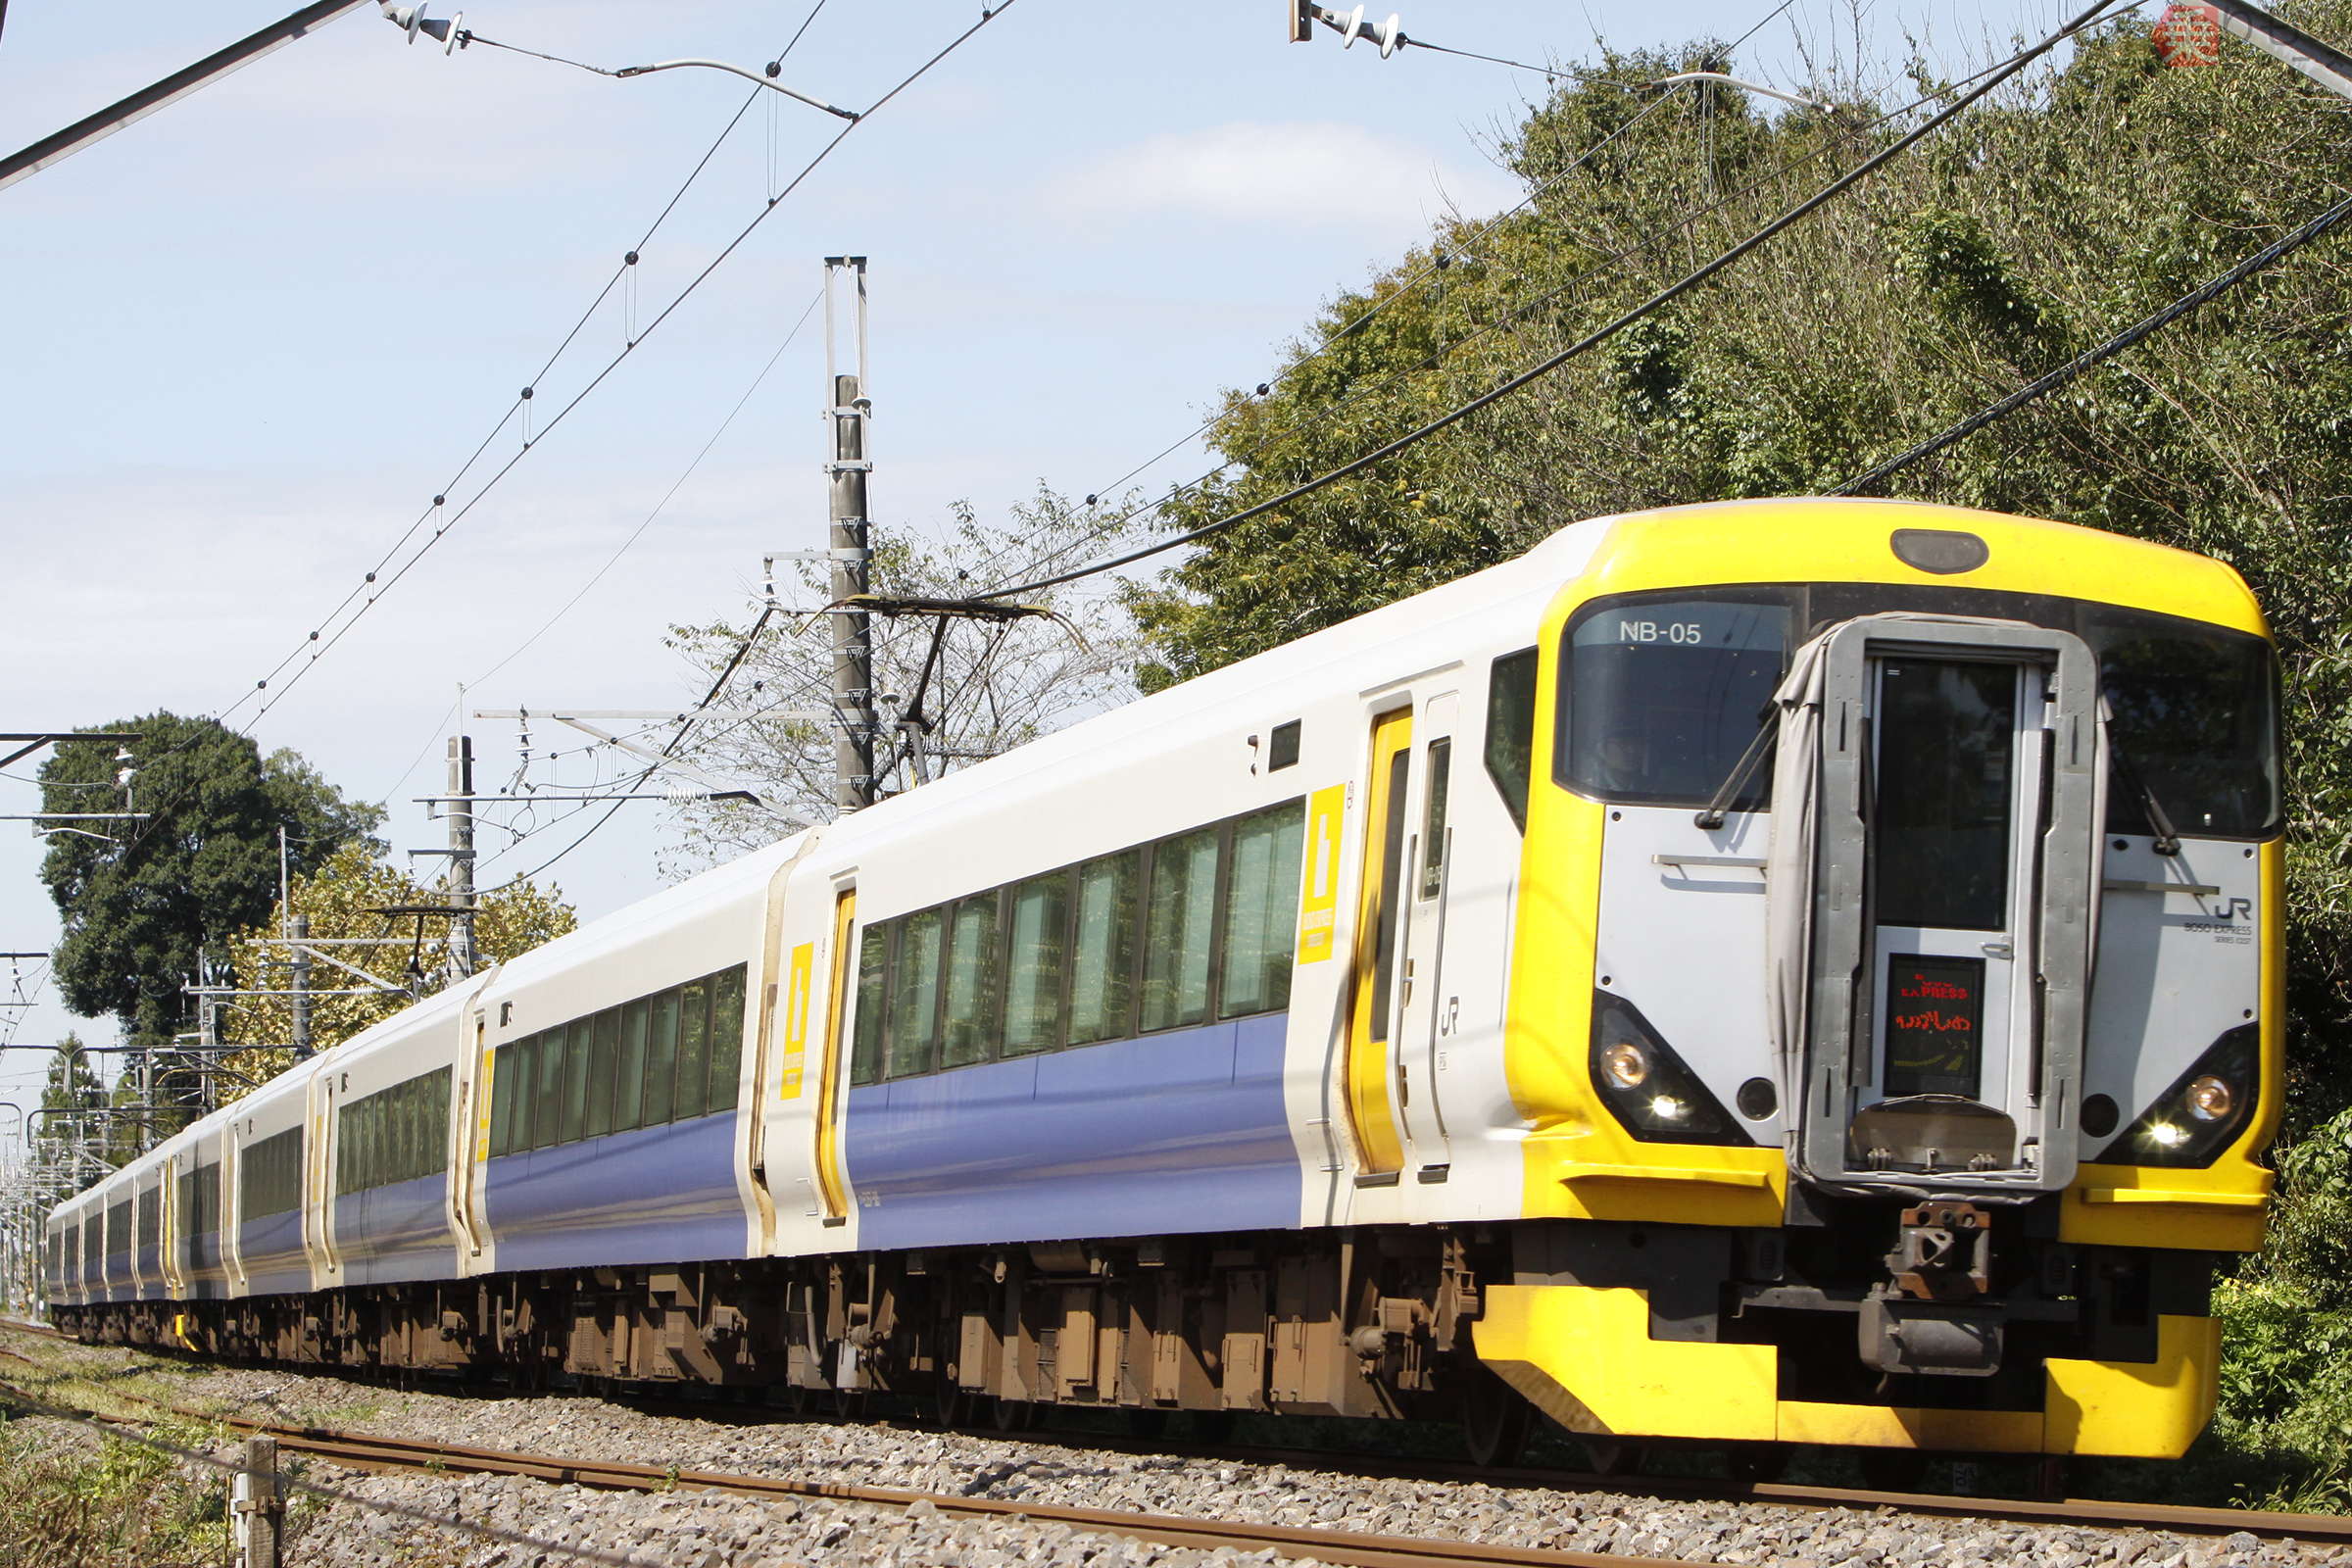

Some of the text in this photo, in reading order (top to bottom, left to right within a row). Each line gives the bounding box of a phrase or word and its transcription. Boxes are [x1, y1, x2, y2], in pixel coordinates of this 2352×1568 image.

[1620, 620, 1701, 644] NB-05
[2214, 897, 2252, 920] JR
[2214, 924, 2252, 936] EXPRESS
[1441, 996, 1458, 1037] JR
